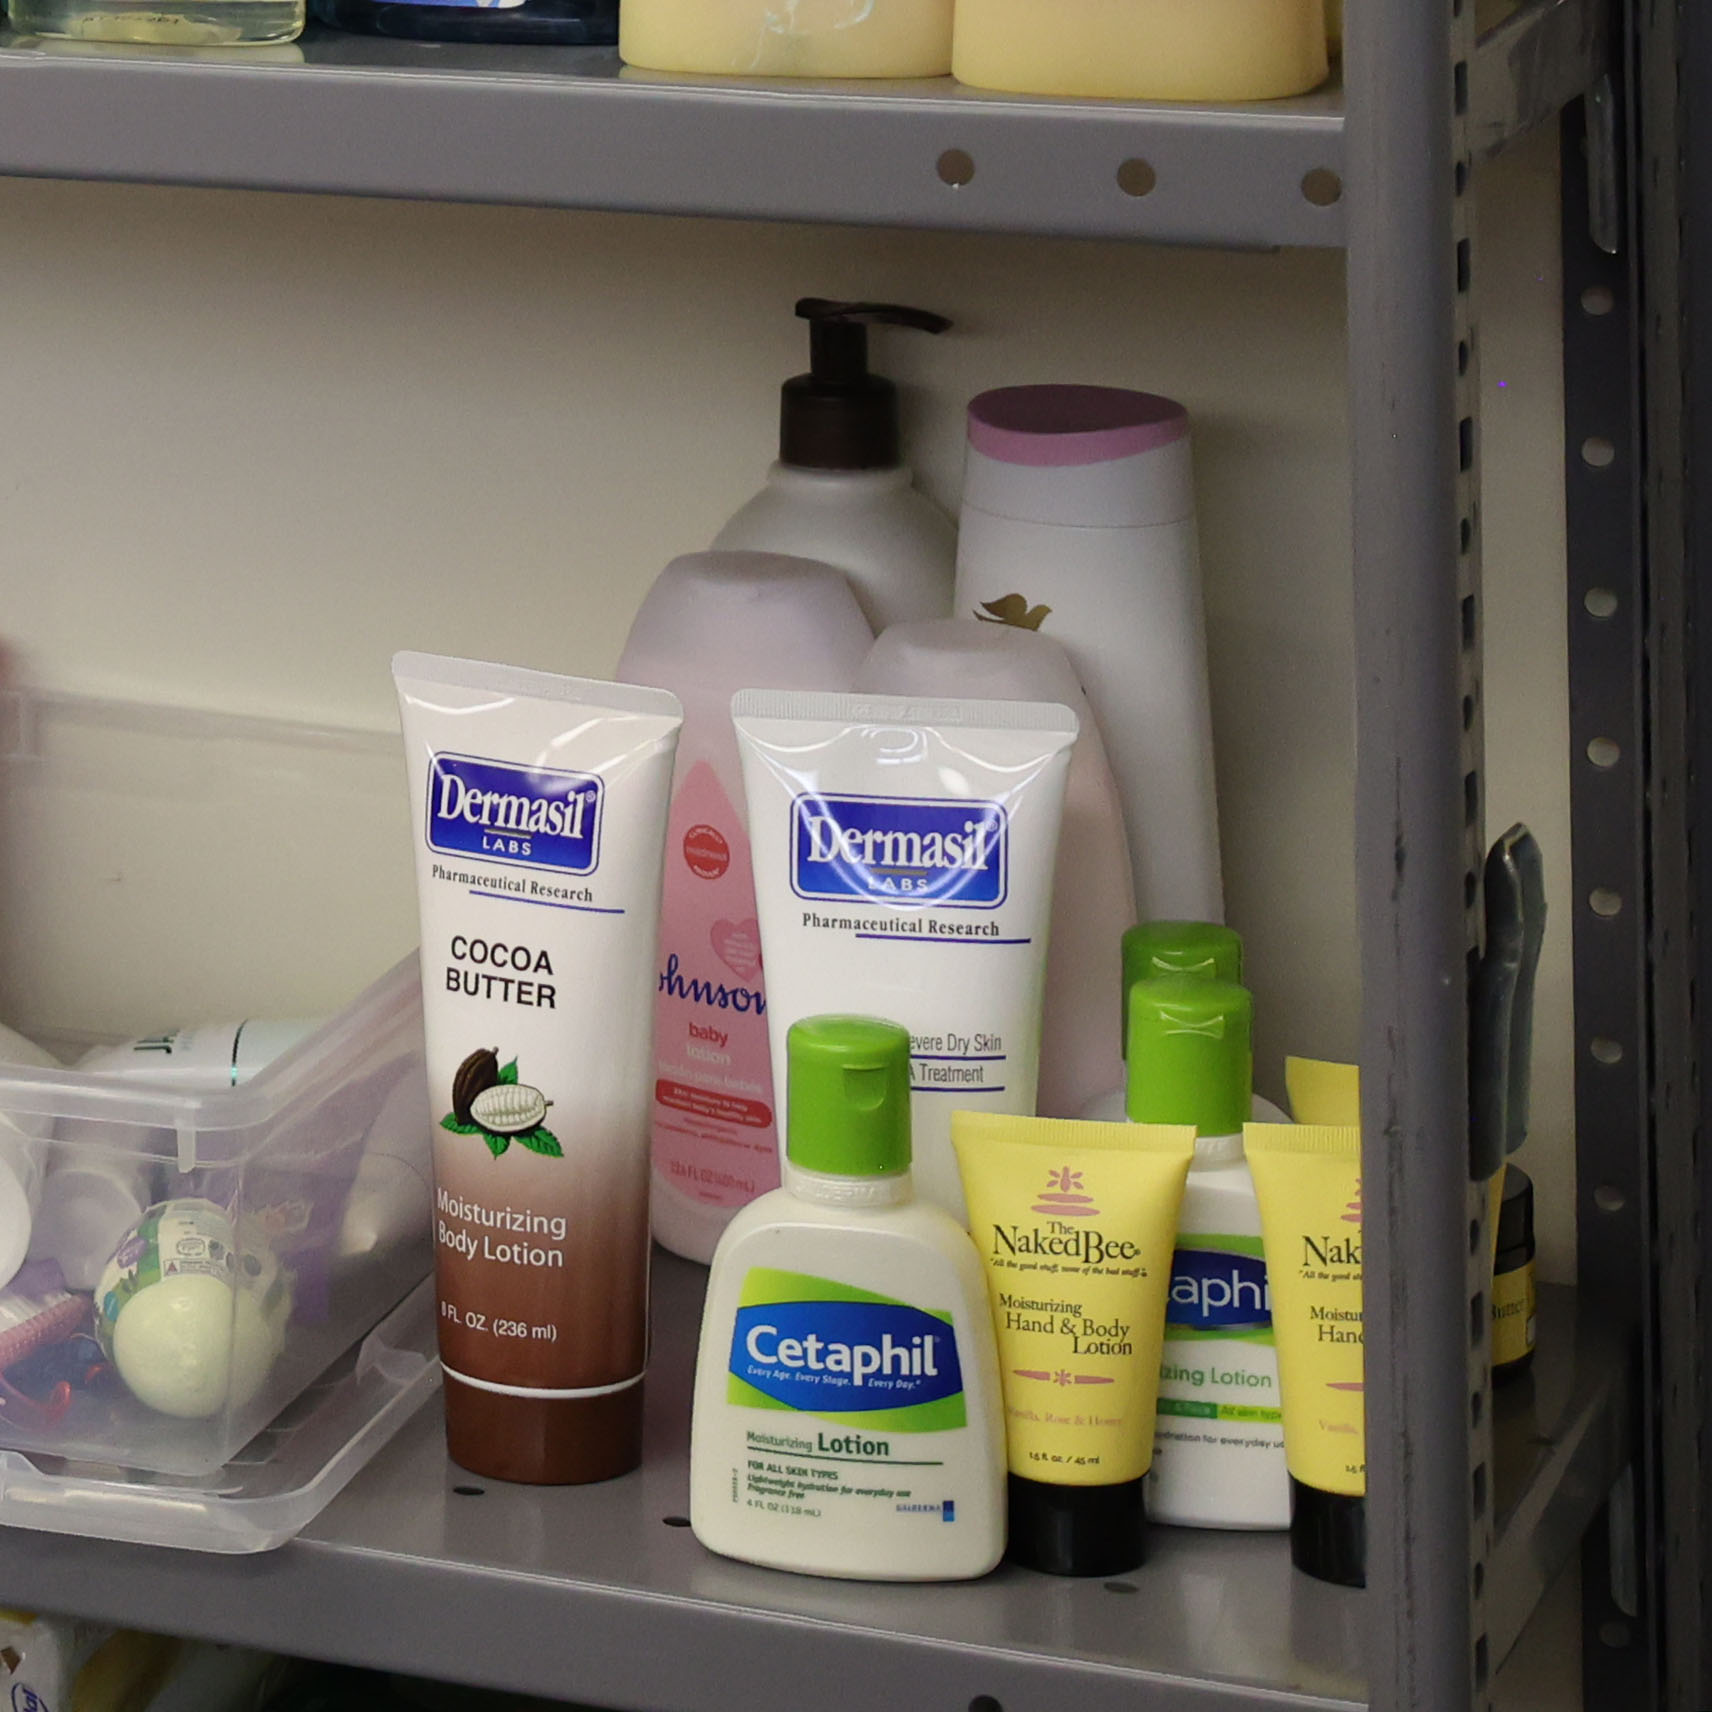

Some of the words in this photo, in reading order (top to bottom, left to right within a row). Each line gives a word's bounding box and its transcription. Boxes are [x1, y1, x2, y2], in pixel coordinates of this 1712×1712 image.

[438, 774, 585, 838] Dermasil
[482, 836, 532, 856] LABS
[807, 815, 989, 871] Dermasil
[432, 864, 526, 893] Pharmaceutical
[530, 881, 593, 902] Research
[868, 877, 928, 892] LABS
[802, 912, 923, 934] Pharmaceutical
[928, 918, 1001, 937] Research
[451, 935, 554, 975] COCOA
[446, 967, 556, 1009] BUTTER
[947, 1033, 969, 1055] Dry
[974, 1034, 1001, 1052] Skin
[920, 1064, 984, 1083] Treatment
[436, 1188, 567, 1242] Moisturizing
[438, 1218, 478, 1261] Body
[483, 1232, 565, 1268] Lotion
[1000, 1293, 1083, 1318] Moisturizing
[1006, 1312, 1054, 1334] Hand
[1082, 1319, 1130, 1344] Body
[746, 1324, 938, 1386] Cetaphil
[1072, 1337, 1132, 1355] Lotion
[748, 1365, 771, 1378] Every
[795, 1371, 821, 1384] Every
[868, 1378, 893, 1390] Every
[1211, 1367, 1272, 1388] Lotion
[818, 1433, 889, 1455] Lotion
[748, 1460, 764, 1471] FOR
[766, 1463, 783, 1472] ALL
[785, 1465, 807, 1476] SKIN
[810, 1469, 838, 1480] TYPES
